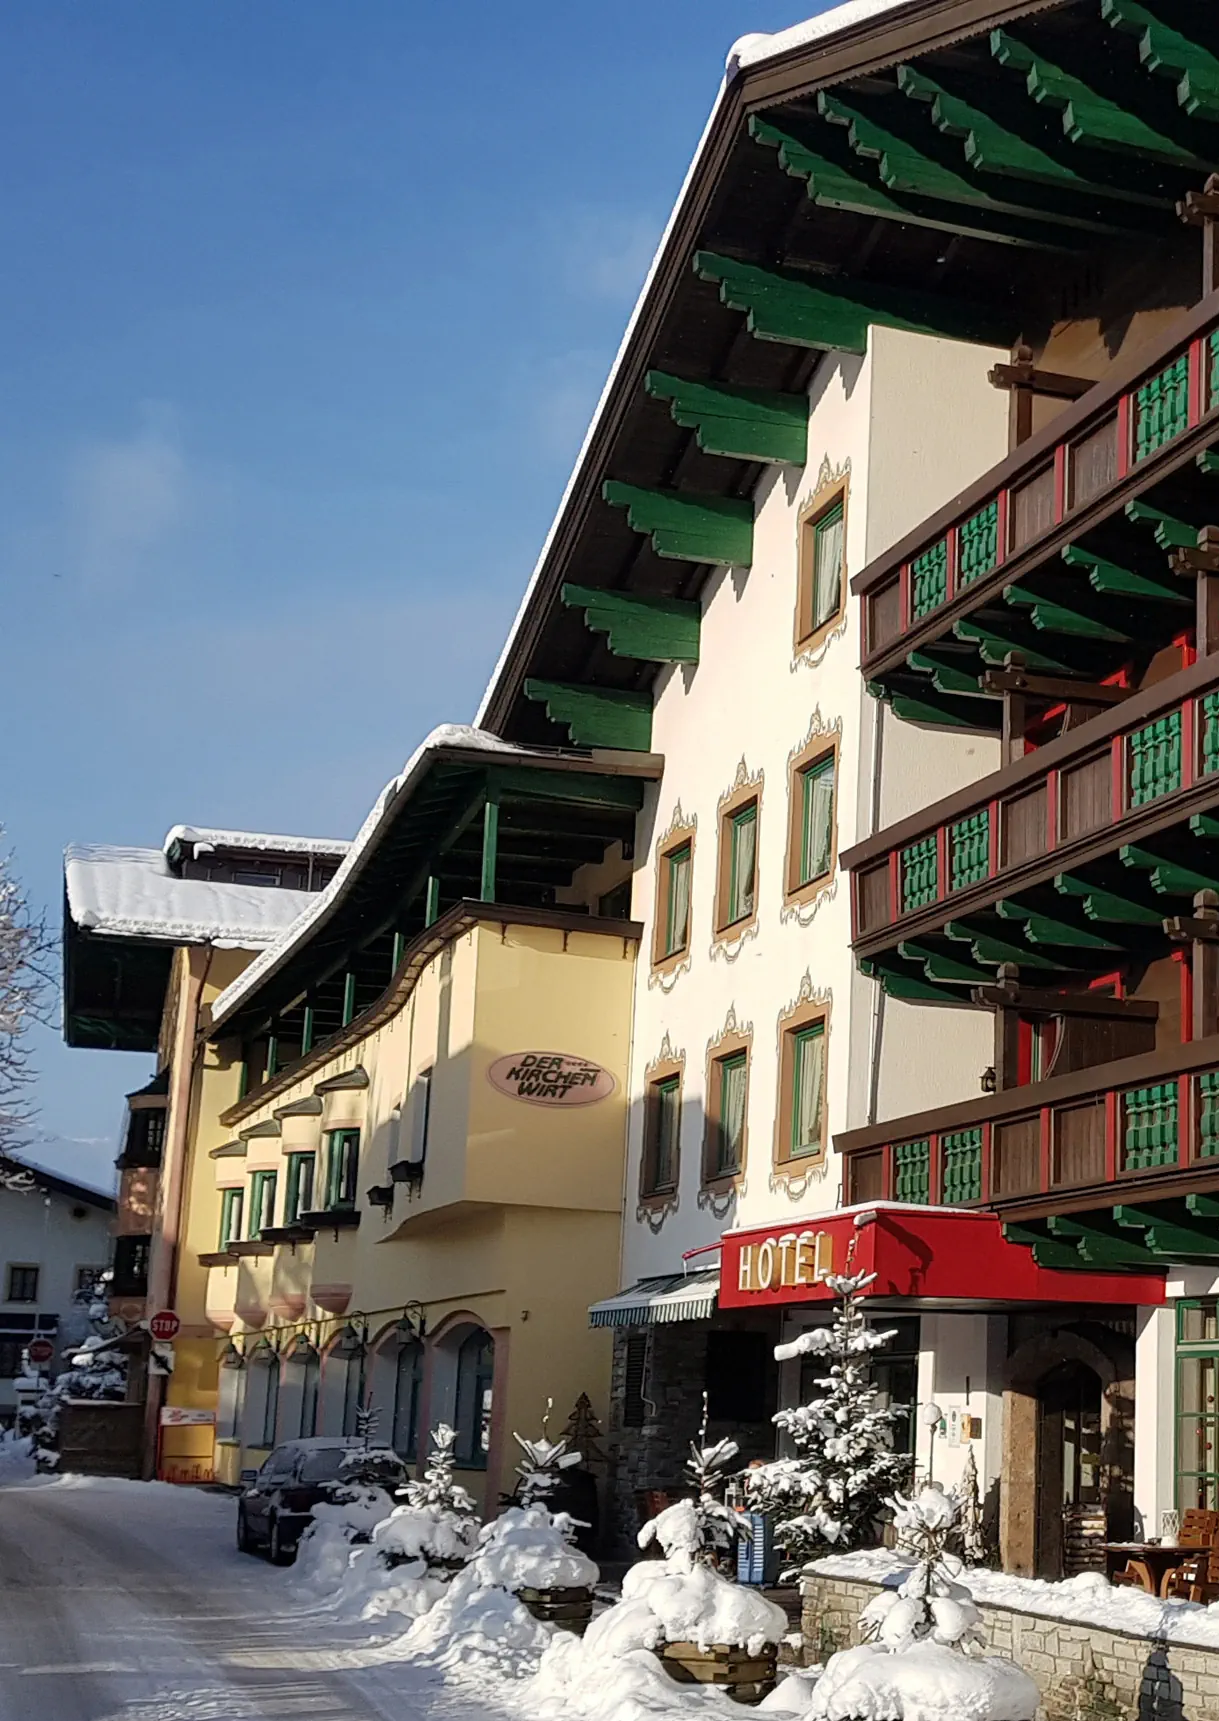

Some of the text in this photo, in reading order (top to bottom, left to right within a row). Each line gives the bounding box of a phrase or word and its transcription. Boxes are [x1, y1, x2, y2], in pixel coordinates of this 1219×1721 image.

[519, 1054, 565, 1069] DER
[506, 1067, 600, 1086] KIRCHEN
[517, 1081, 572, 1099] WIRT
[739, 1232, 832, 1291] HOTEL
[152, 1319, 178, 1331] STOP
